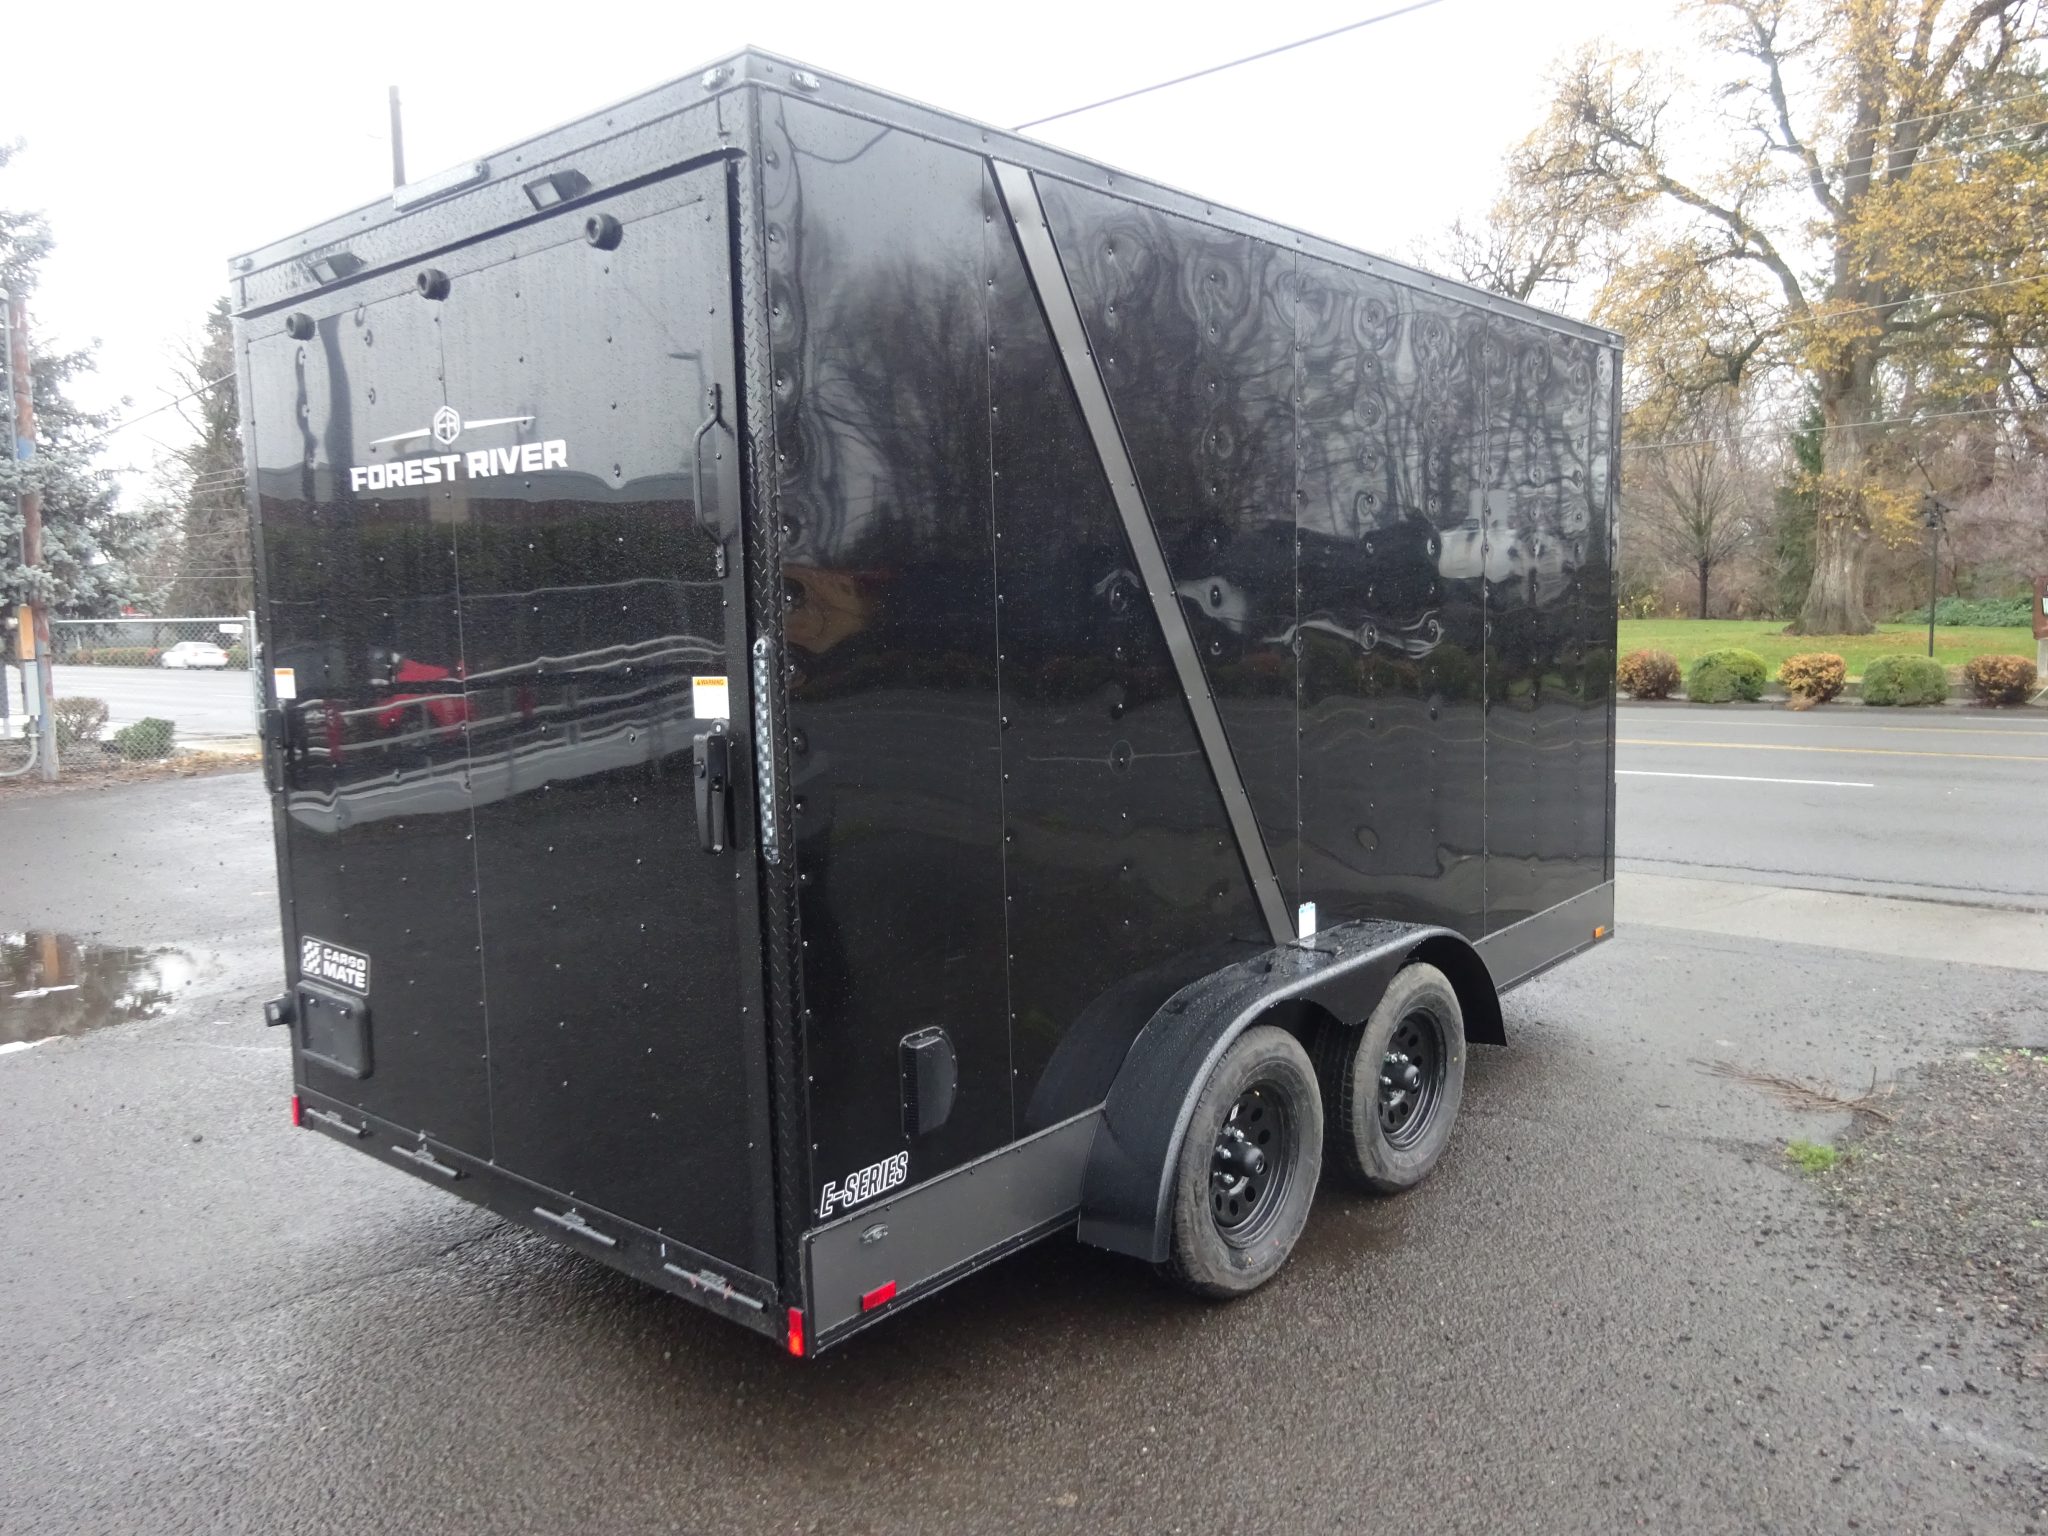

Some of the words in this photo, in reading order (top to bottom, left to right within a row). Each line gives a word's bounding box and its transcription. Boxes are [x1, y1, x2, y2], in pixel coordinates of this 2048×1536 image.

[350, 454, 460, 492] FOREST
[465, 439, 568, 479] RIVER
[323, 947, 366, 971] CARGO
[323, 960, 366, 989] MATE
[820, 1150, 908, 1218] E-SERIES
